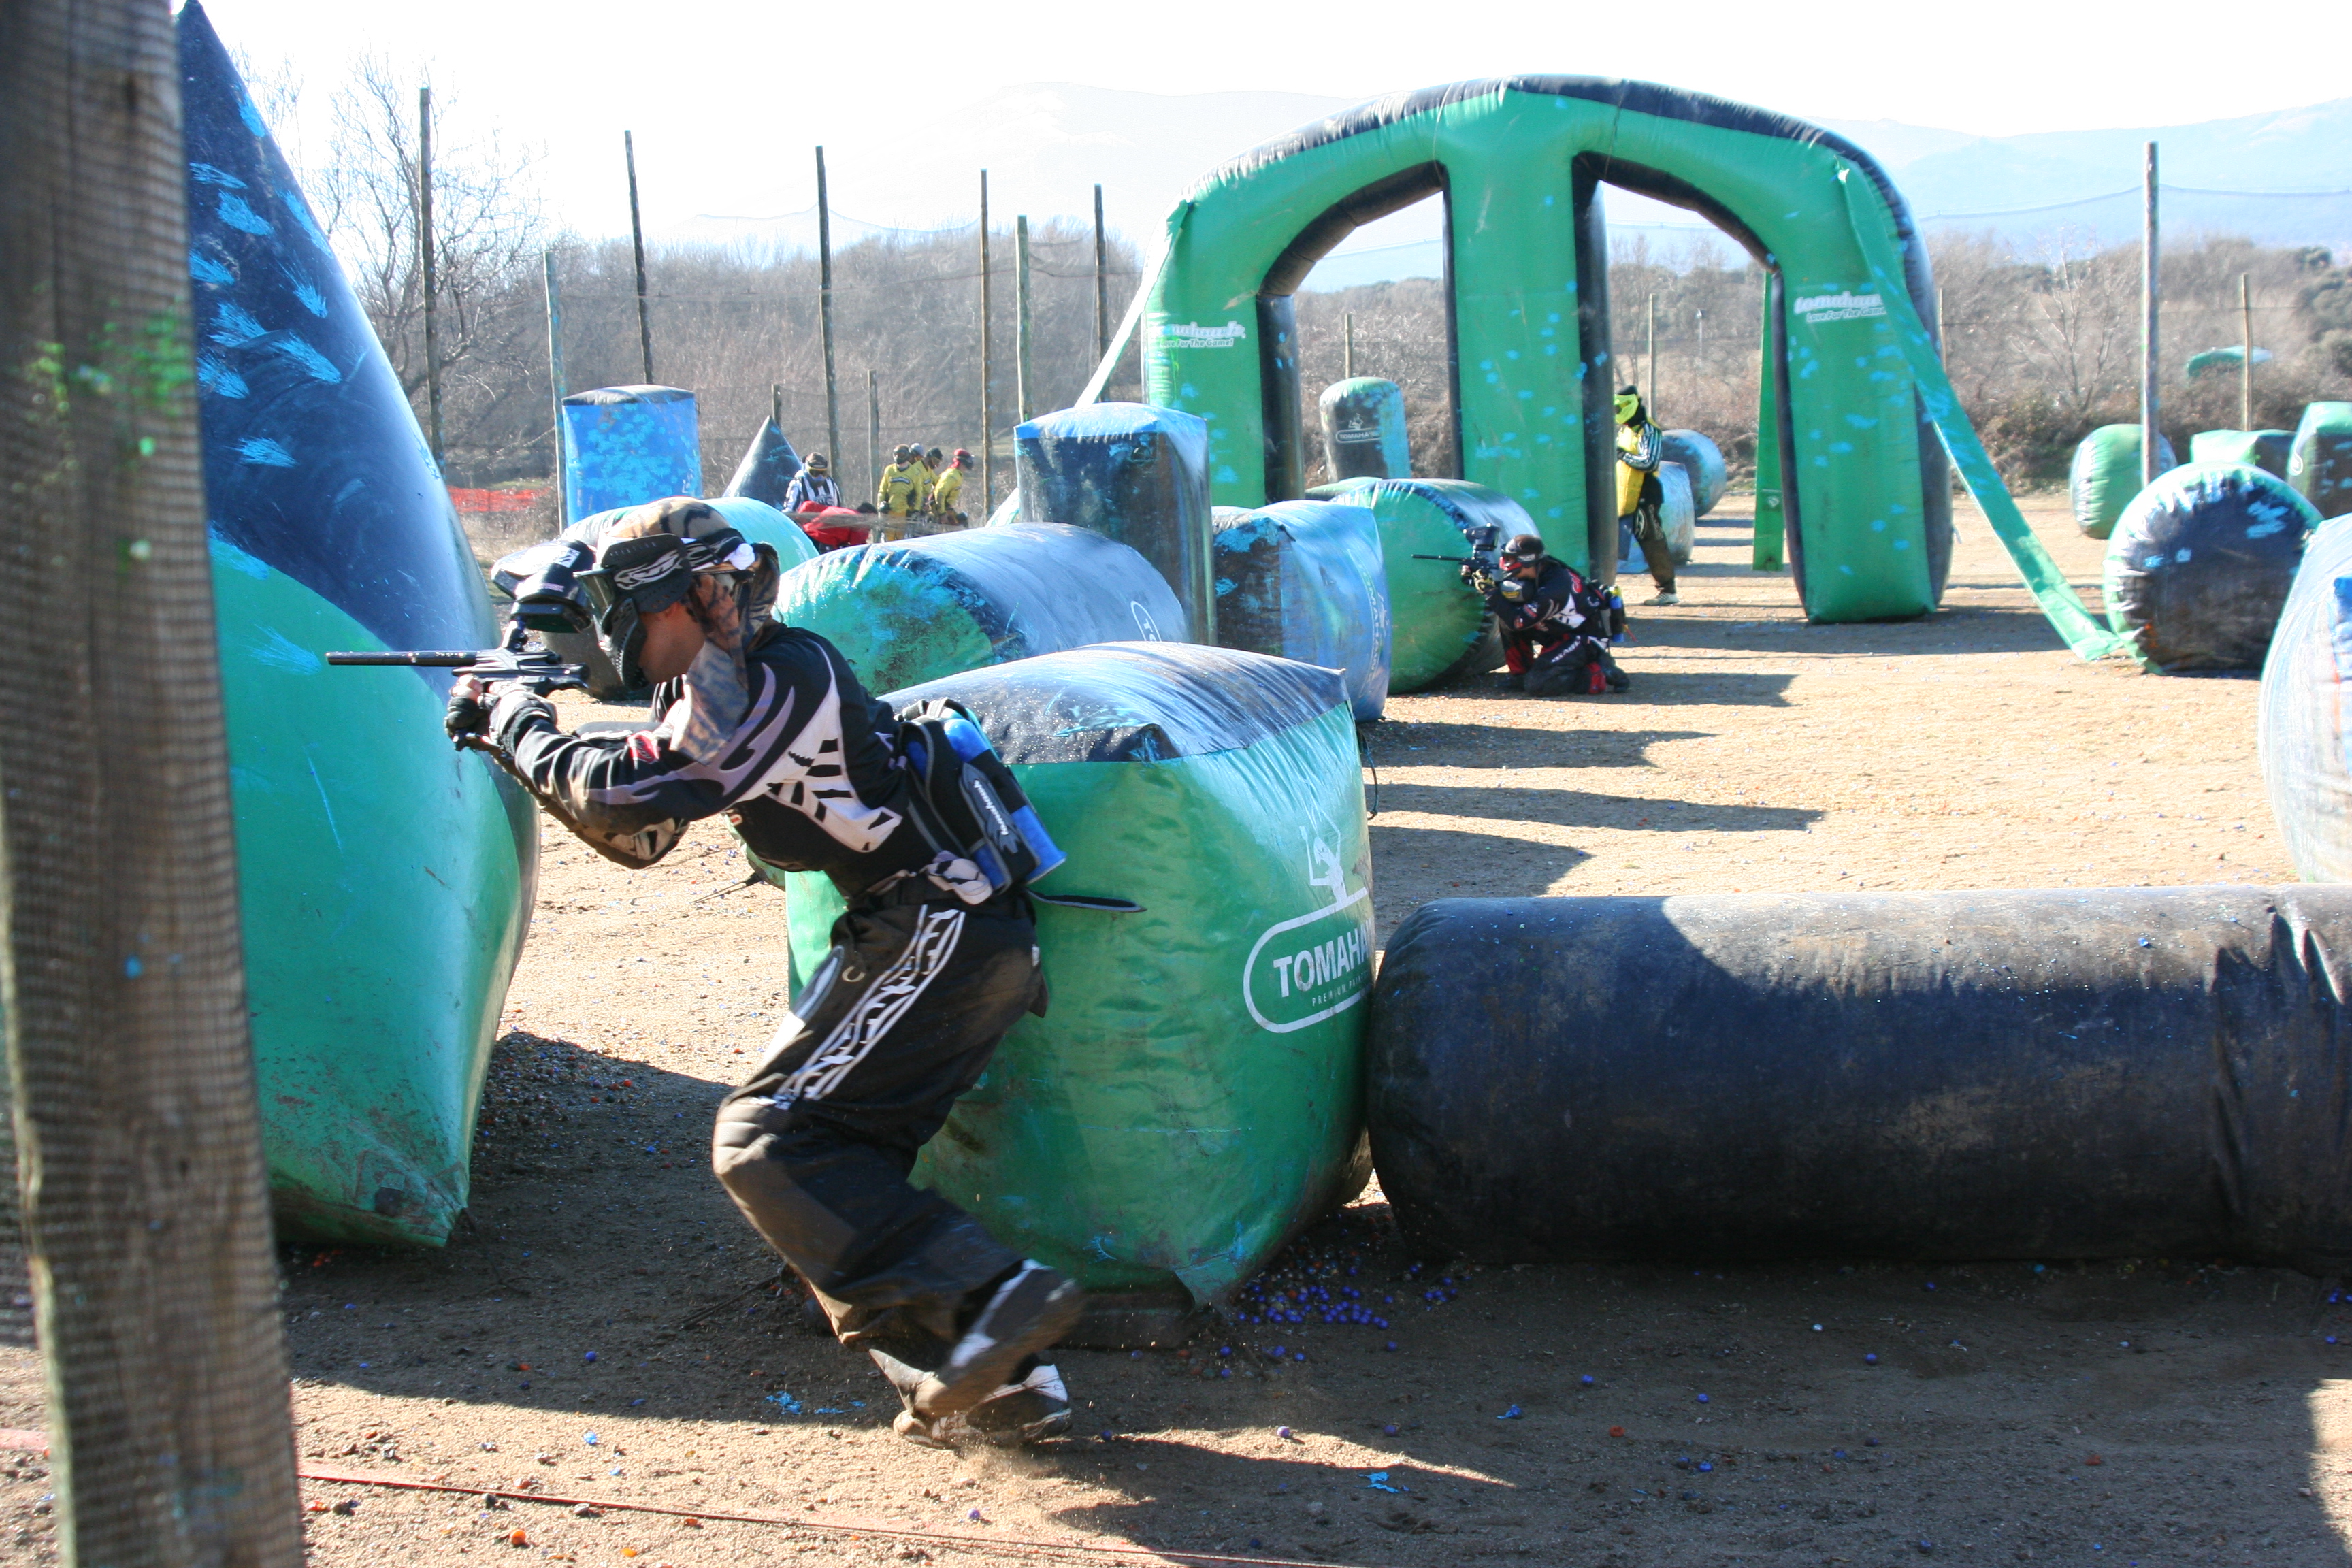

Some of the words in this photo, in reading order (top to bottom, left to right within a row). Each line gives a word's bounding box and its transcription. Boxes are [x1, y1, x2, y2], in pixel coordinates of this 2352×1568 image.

[1794, 291, 1883, 314] tomahaw
[1807, 313, 1826, 323] Love
[1827, 310, 1842, 320] For
[1842, 309, 1859, 318] The
[1190, 338, 1205, 347] The
[1206, 338, 1234, 347] Game!
[1311, 984, 1347, 1007] PREMIUM
